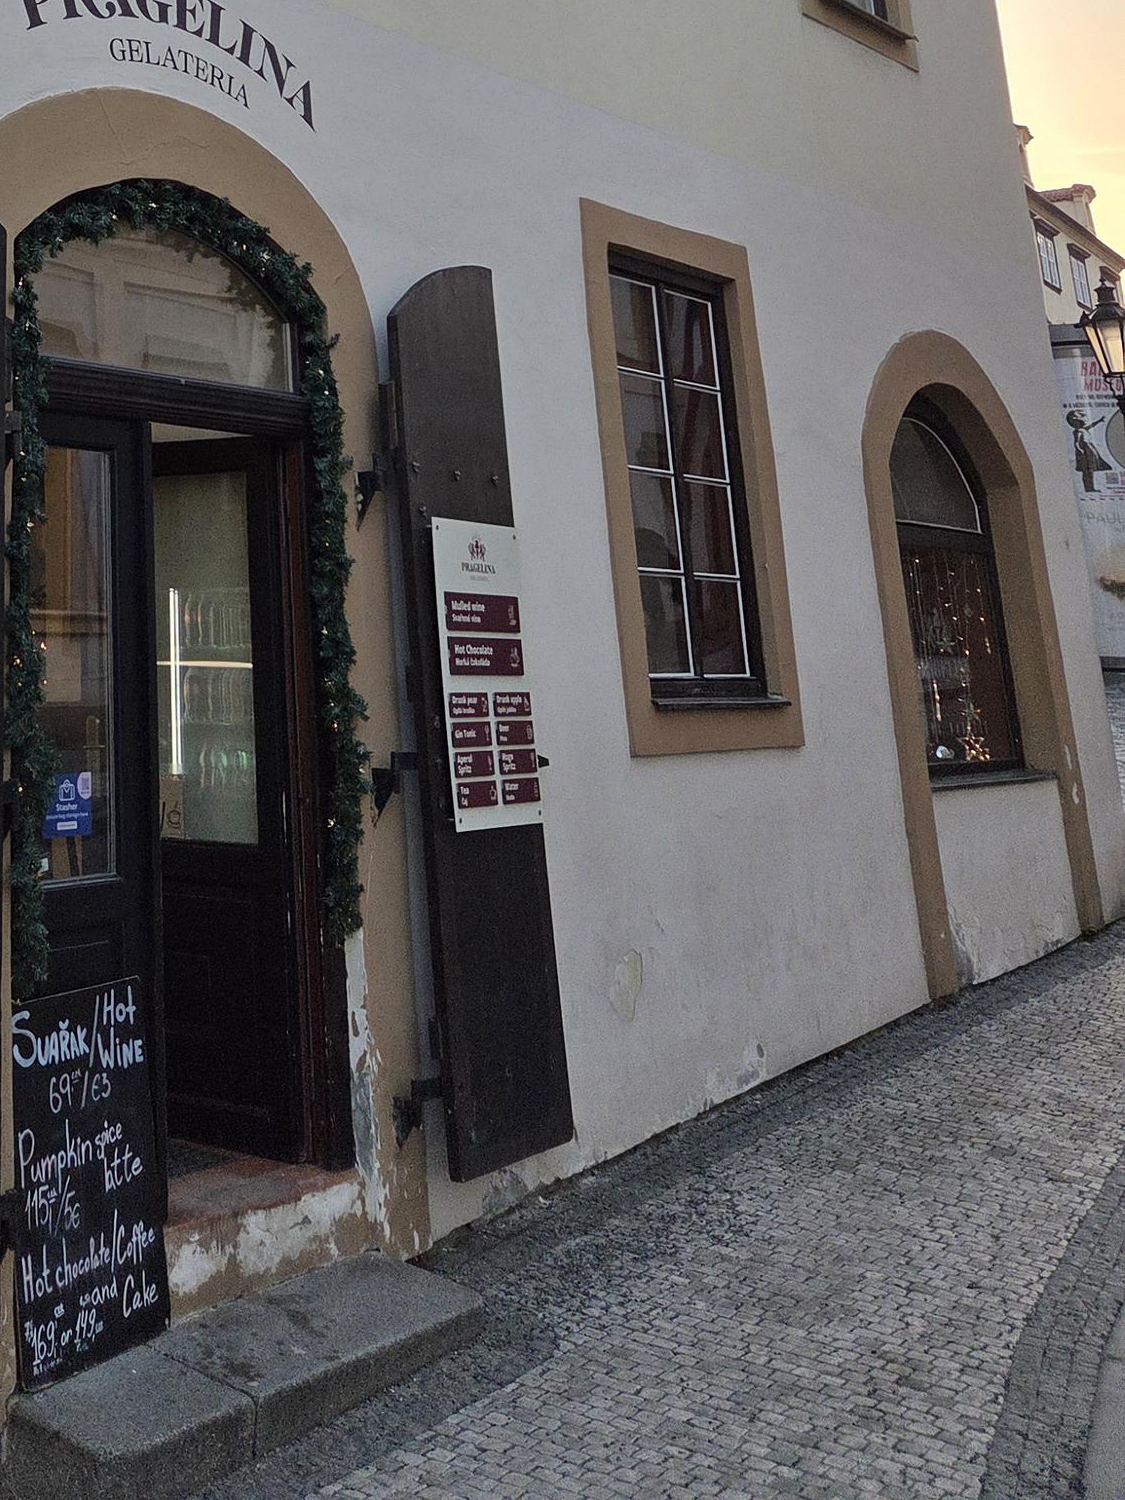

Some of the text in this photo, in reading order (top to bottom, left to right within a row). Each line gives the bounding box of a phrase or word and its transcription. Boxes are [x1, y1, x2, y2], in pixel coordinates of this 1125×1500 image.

[109, 37, 250, 110] GELATERIA
[18, 1118, 122, 1194] Pumpkin spice
[21, 1244, 53, 1304] Hot
[91, 1270, 158, 1318] and Cake
